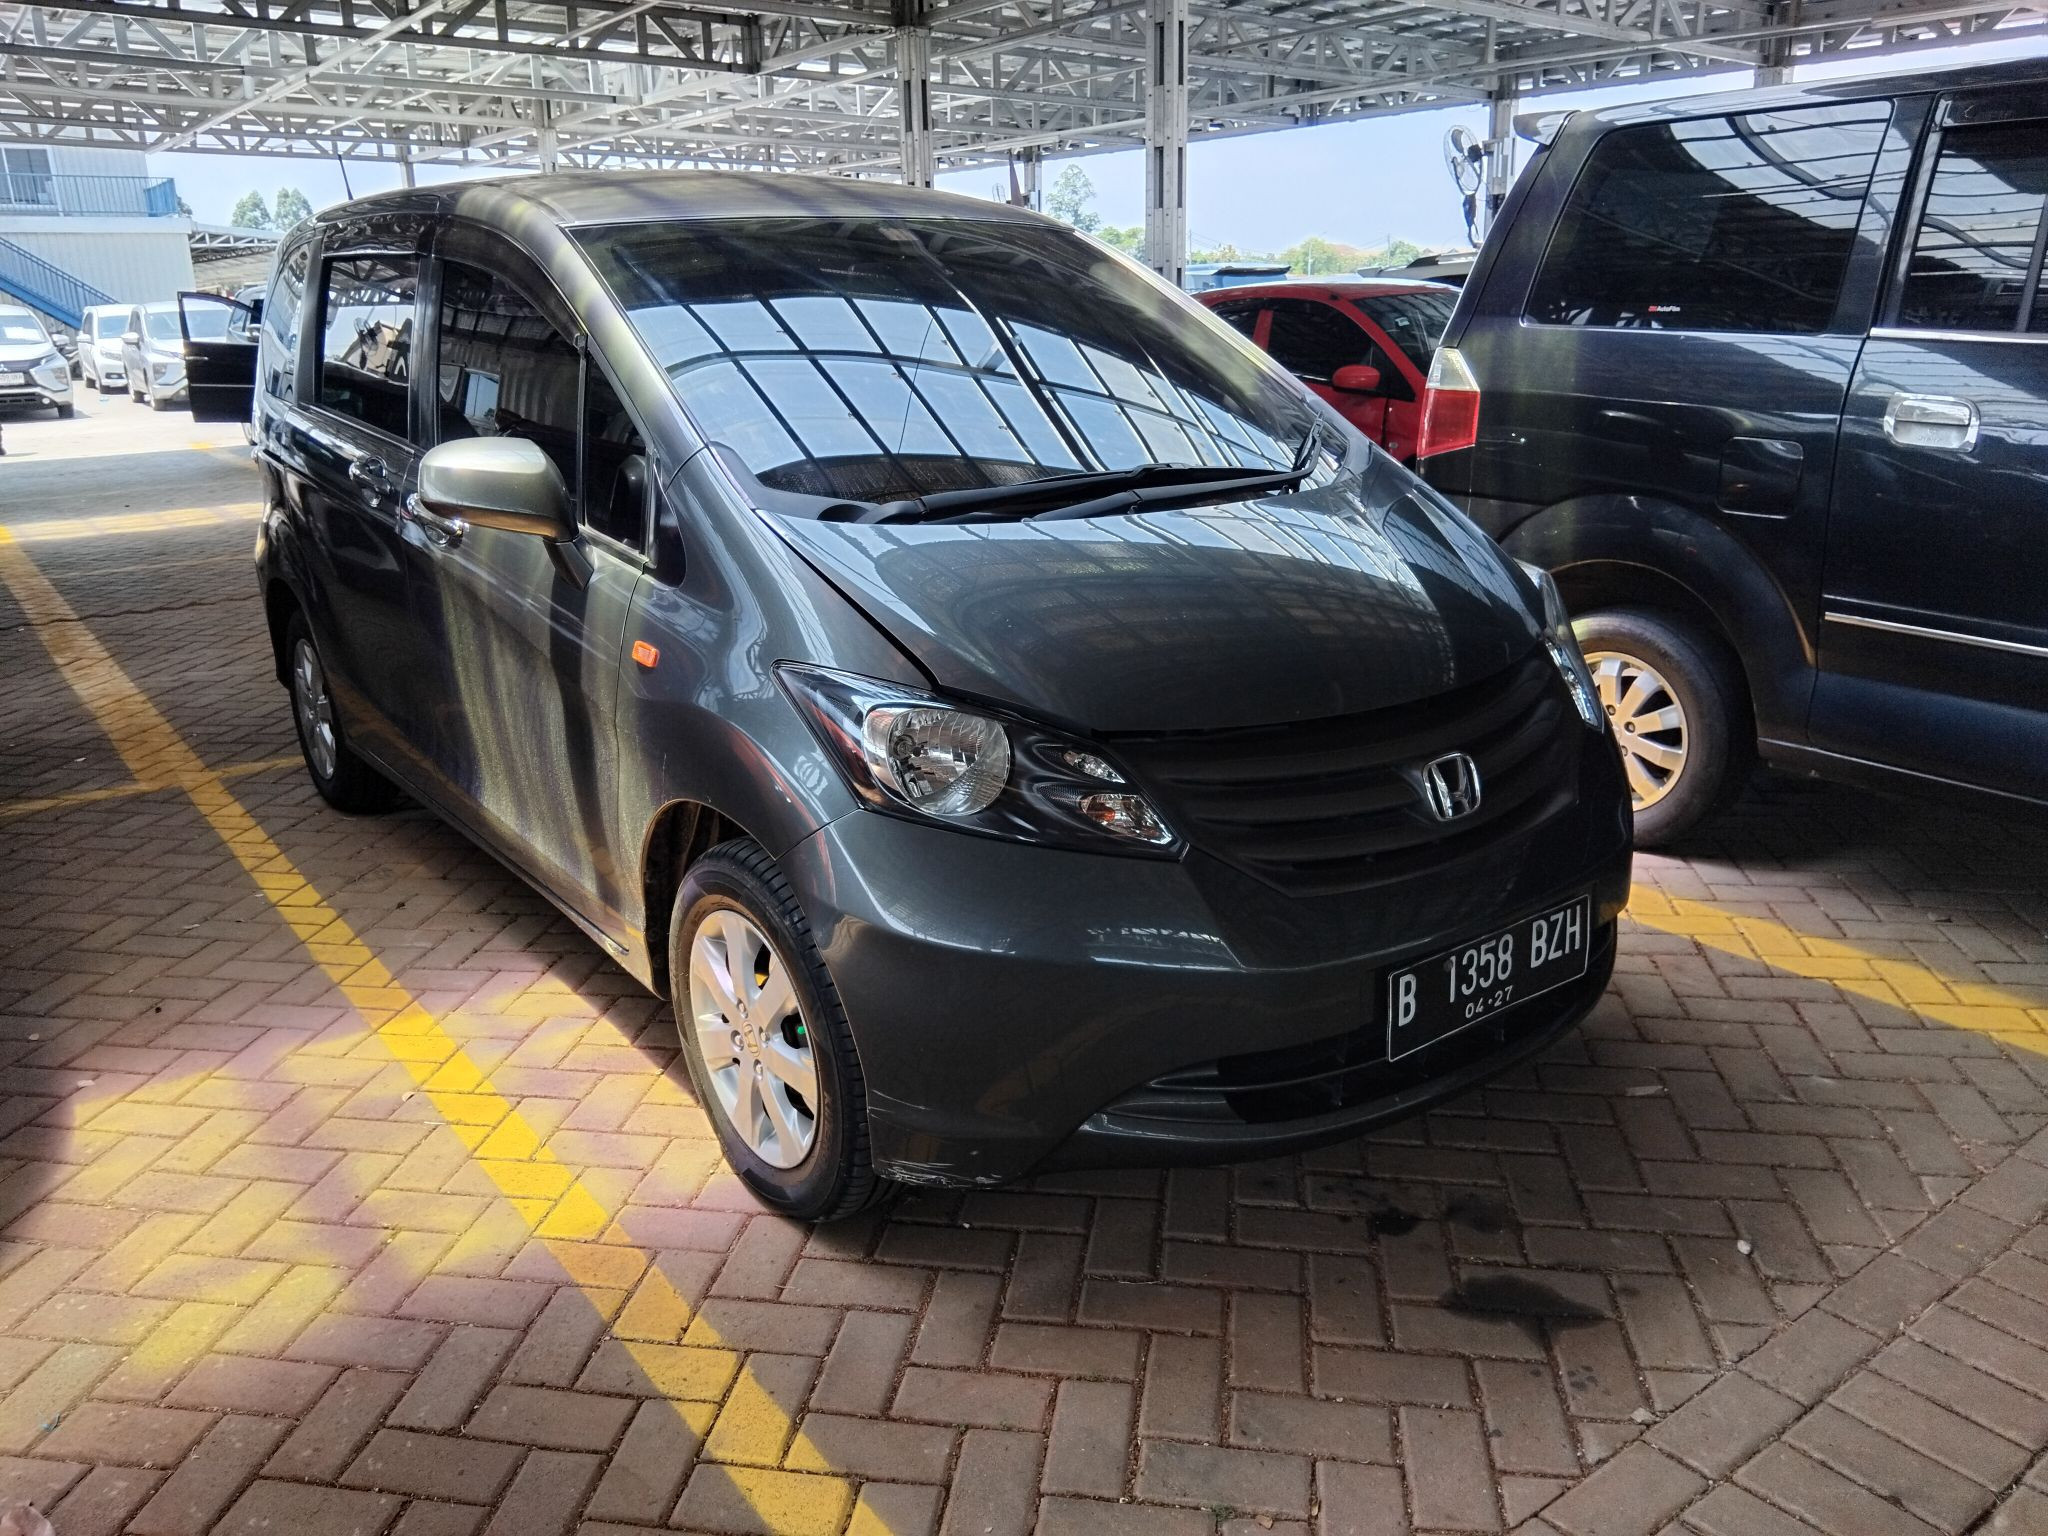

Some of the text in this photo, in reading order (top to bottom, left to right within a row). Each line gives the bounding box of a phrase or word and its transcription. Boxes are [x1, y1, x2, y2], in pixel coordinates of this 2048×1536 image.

[1398, 904, 1581, 1027] B 1358 BZH
